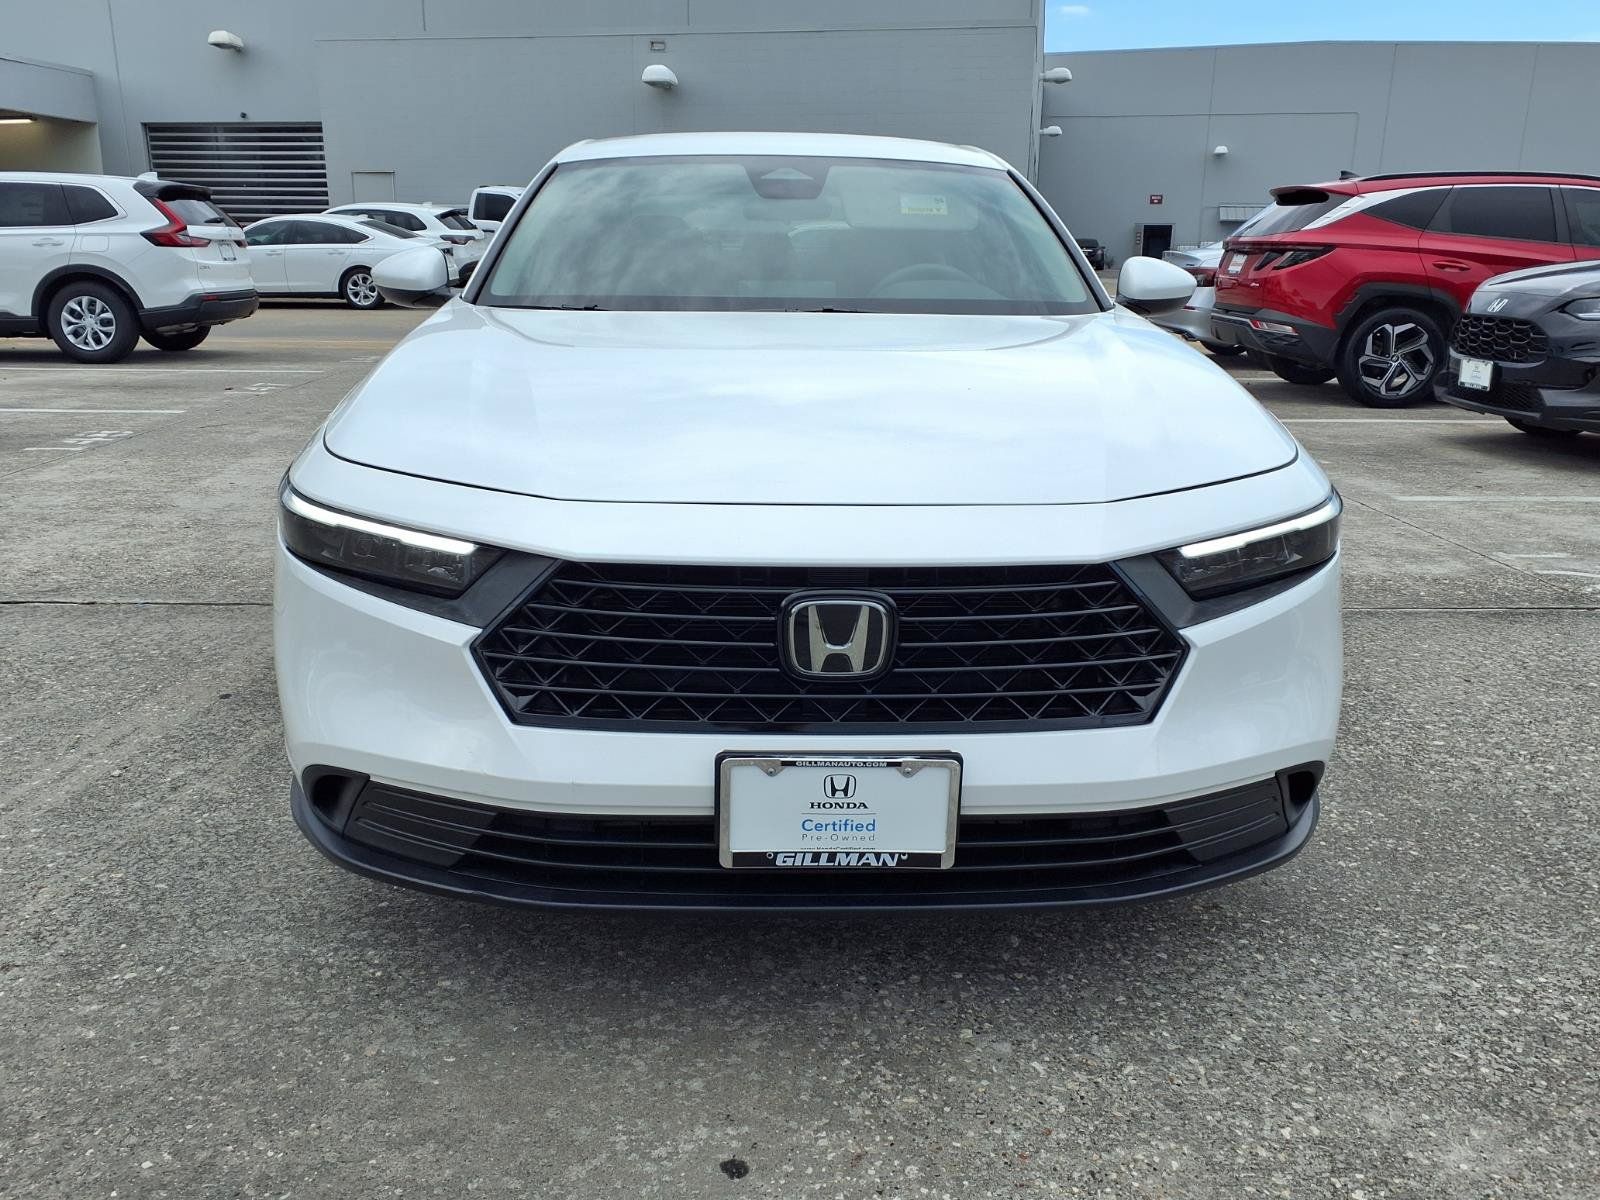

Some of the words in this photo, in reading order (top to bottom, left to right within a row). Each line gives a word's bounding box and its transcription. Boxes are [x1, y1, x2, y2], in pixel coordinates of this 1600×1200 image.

[795, 760, 888, 768] GILLMANAUTO.COM
[809, 801, 869, 809] HONDA
[801, 818, 876, 832] Certified
[801, 833, 876, 842] Pre-Owned
[775, 852, 899, 867] GILLMAN
